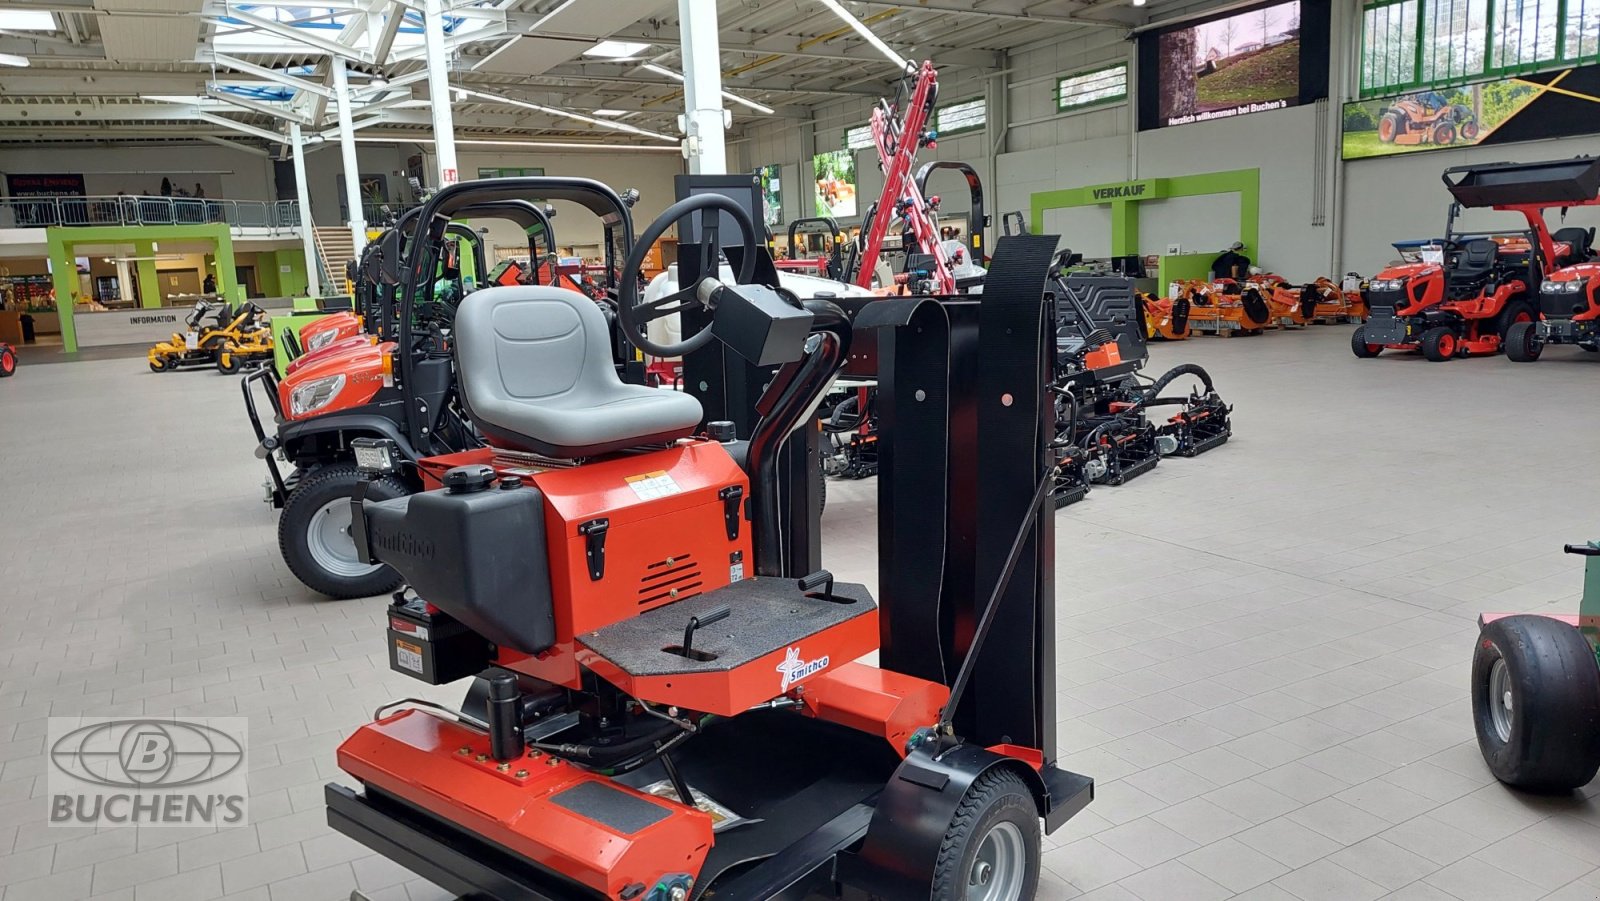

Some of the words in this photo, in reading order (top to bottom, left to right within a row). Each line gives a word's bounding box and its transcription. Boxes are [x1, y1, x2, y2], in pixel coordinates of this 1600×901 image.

[1168, 115, 1196, 126] Herzlich
[1196, 108, 1237, 121] willkommen
[1238, 104, 1250, 115] bei
[1093, 184, 1146, 200] VERKAUF
[130, 314, 177, 325] INFORMATION
[791, 657, 829, 682] Smithco
